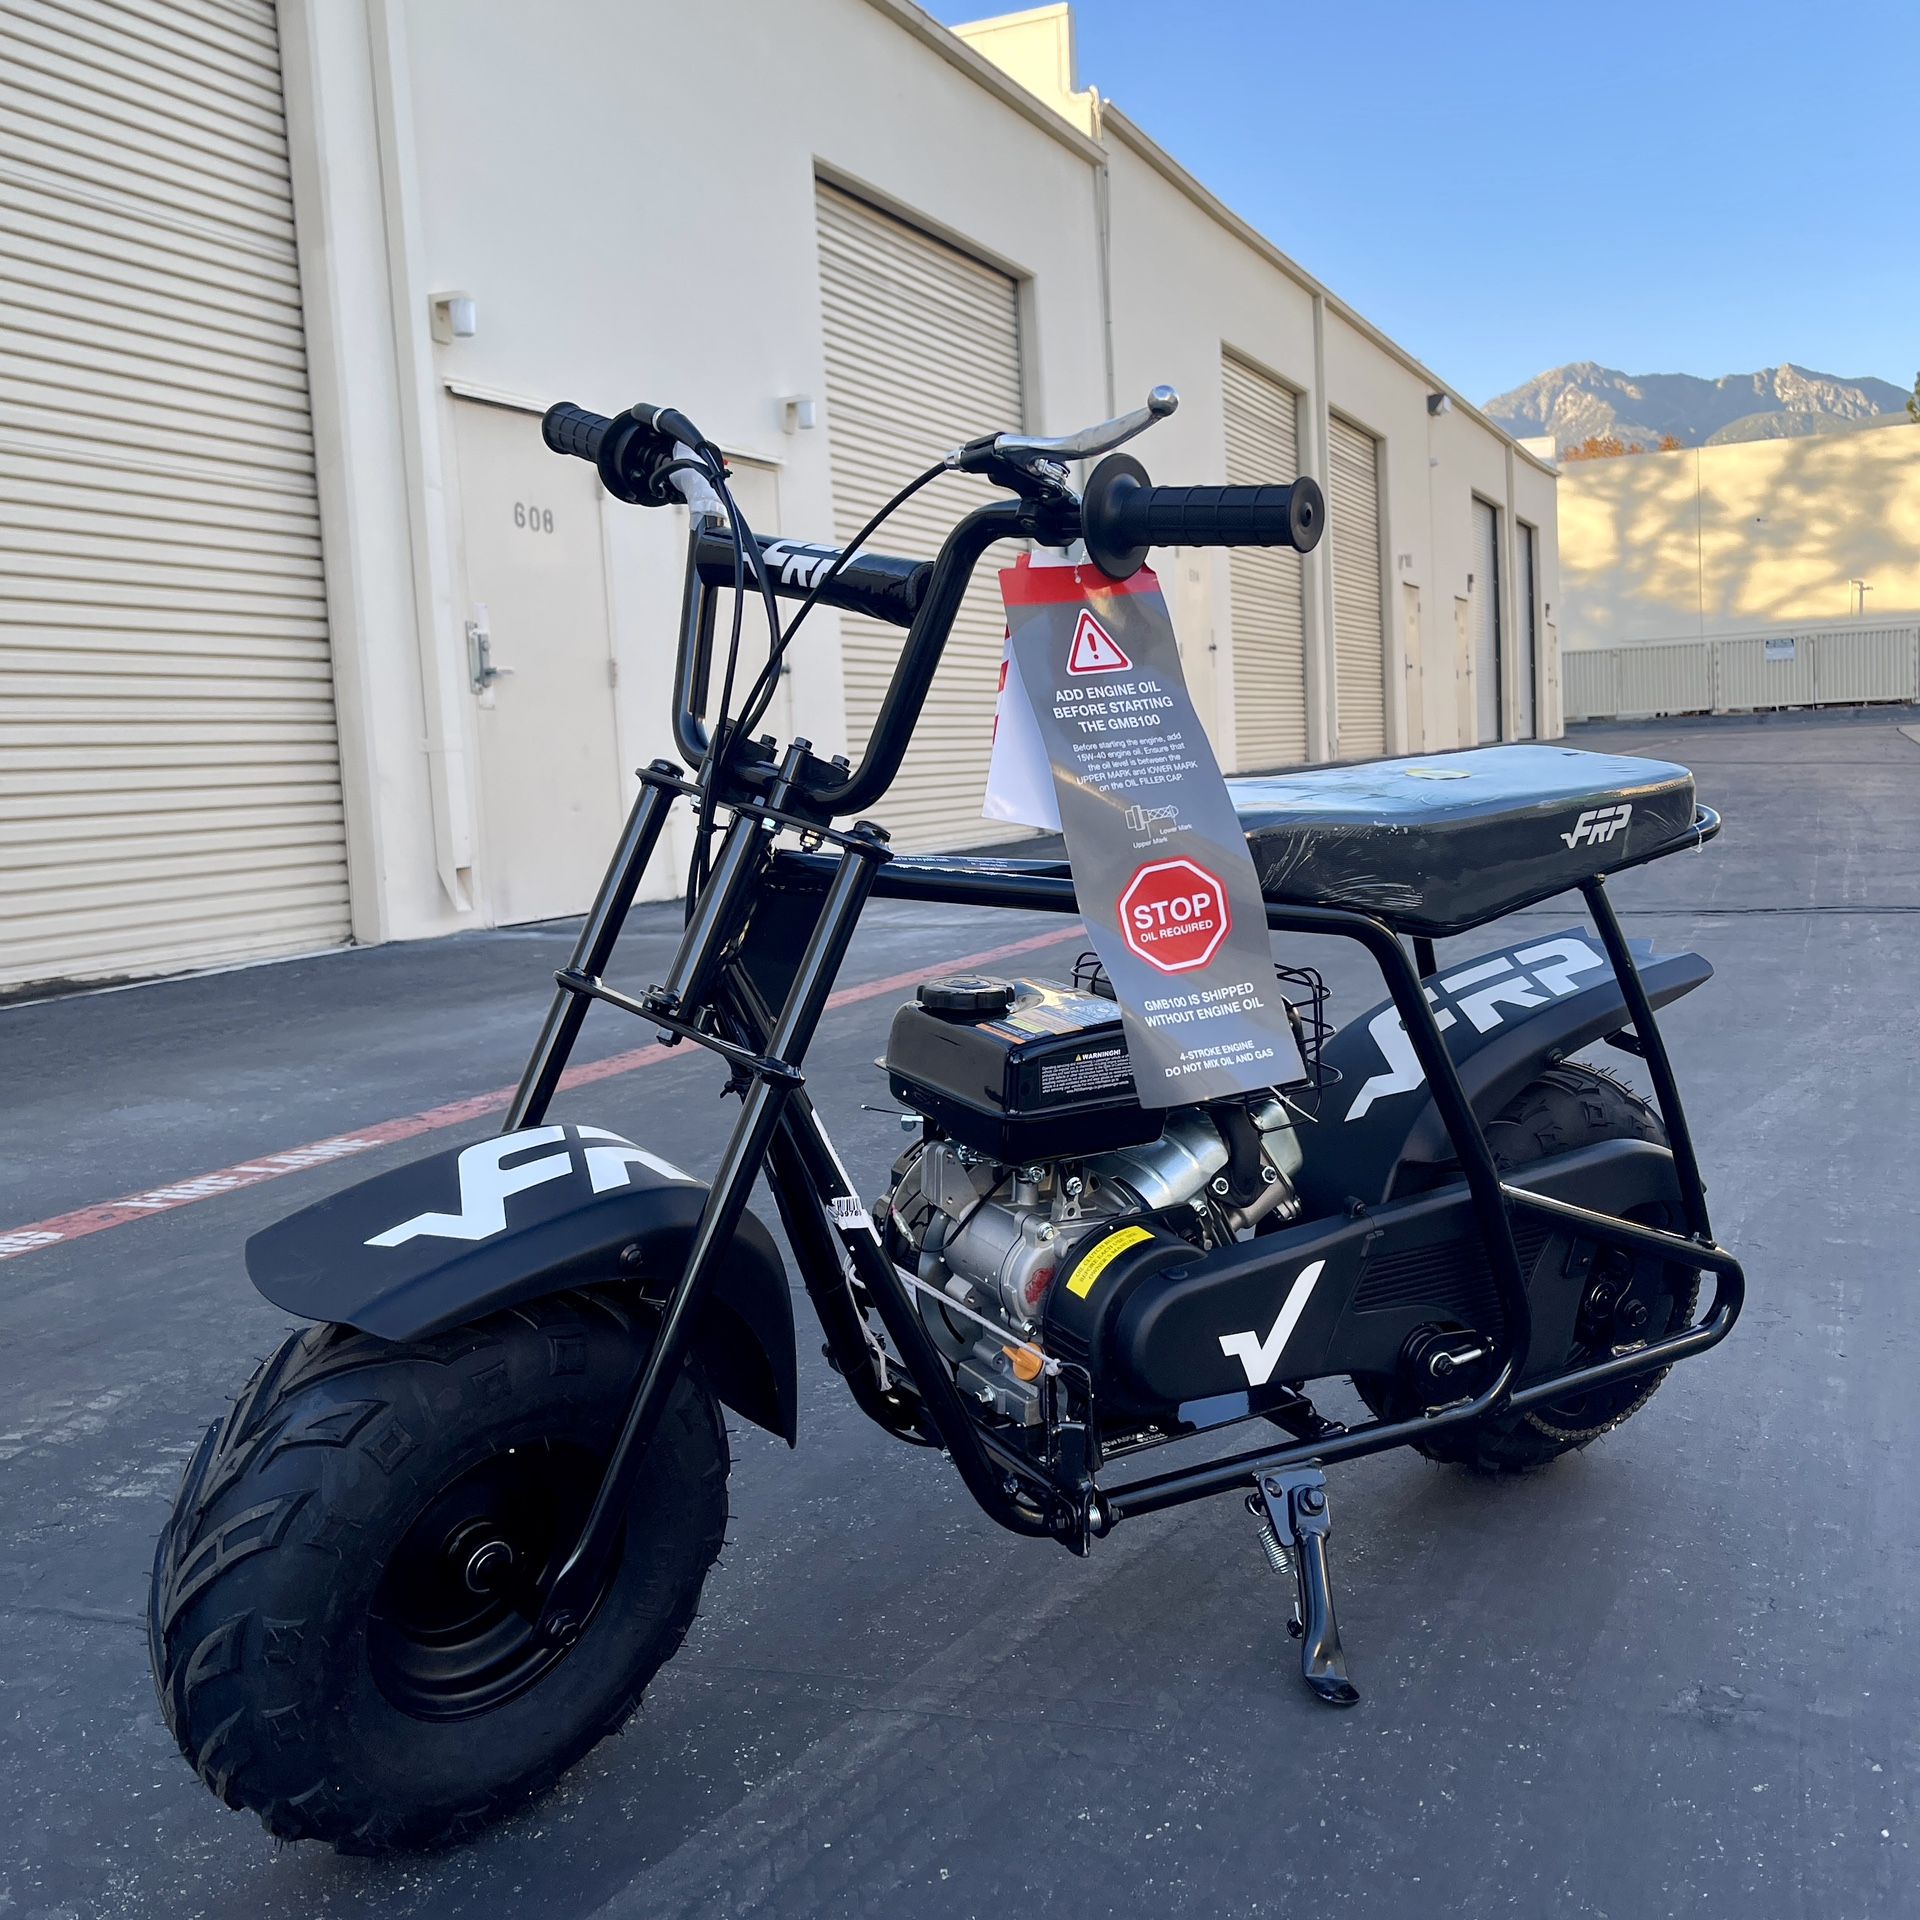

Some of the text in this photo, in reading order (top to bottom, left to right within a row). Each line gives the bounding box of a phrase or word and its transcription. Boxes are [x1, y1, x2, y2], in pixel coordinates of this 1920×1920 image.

[514, 502, 554, 534] 608
[1056, 681, 1161, 702] ADD ENGINE OIL
[1052, 696, 1174, 719] BEFORE STARTING
[1078, 714, 1160, 733] THE GMB100
[1073, 732, 1181, 753] Before starting the engine, add
[1077, 742, 1186, 762] 15W-40 engine oil. Ensure that
[1076, 772, 1106, 785] UPPER
[1107, 768, 1132, 780] MARK
[1132, 767, 1146, 776] and
[1174, 760, 1198, 771] MARK
[1088, 753, 1181, 772] the oil level is between the
[1099, 773, 1184, 792] on the OIL FILLER CAP.
[1560, 803, 1632, 849] FRP
[1134, 893, 1211, 929] STOP
[1140, 920, 1213, 943] OIL REQUIRED
[1144, 982, 1254, 1011] GMB100 IS SHIPPED
[1144, 997, 1264, 1028] WITHOUT ENGINE OIL
[1179, 1040, 1255, 1061] 4-STROKE ENGINE
[1164, 1048, 1274, 1078] DO NOT MIX OIL AND GAS
